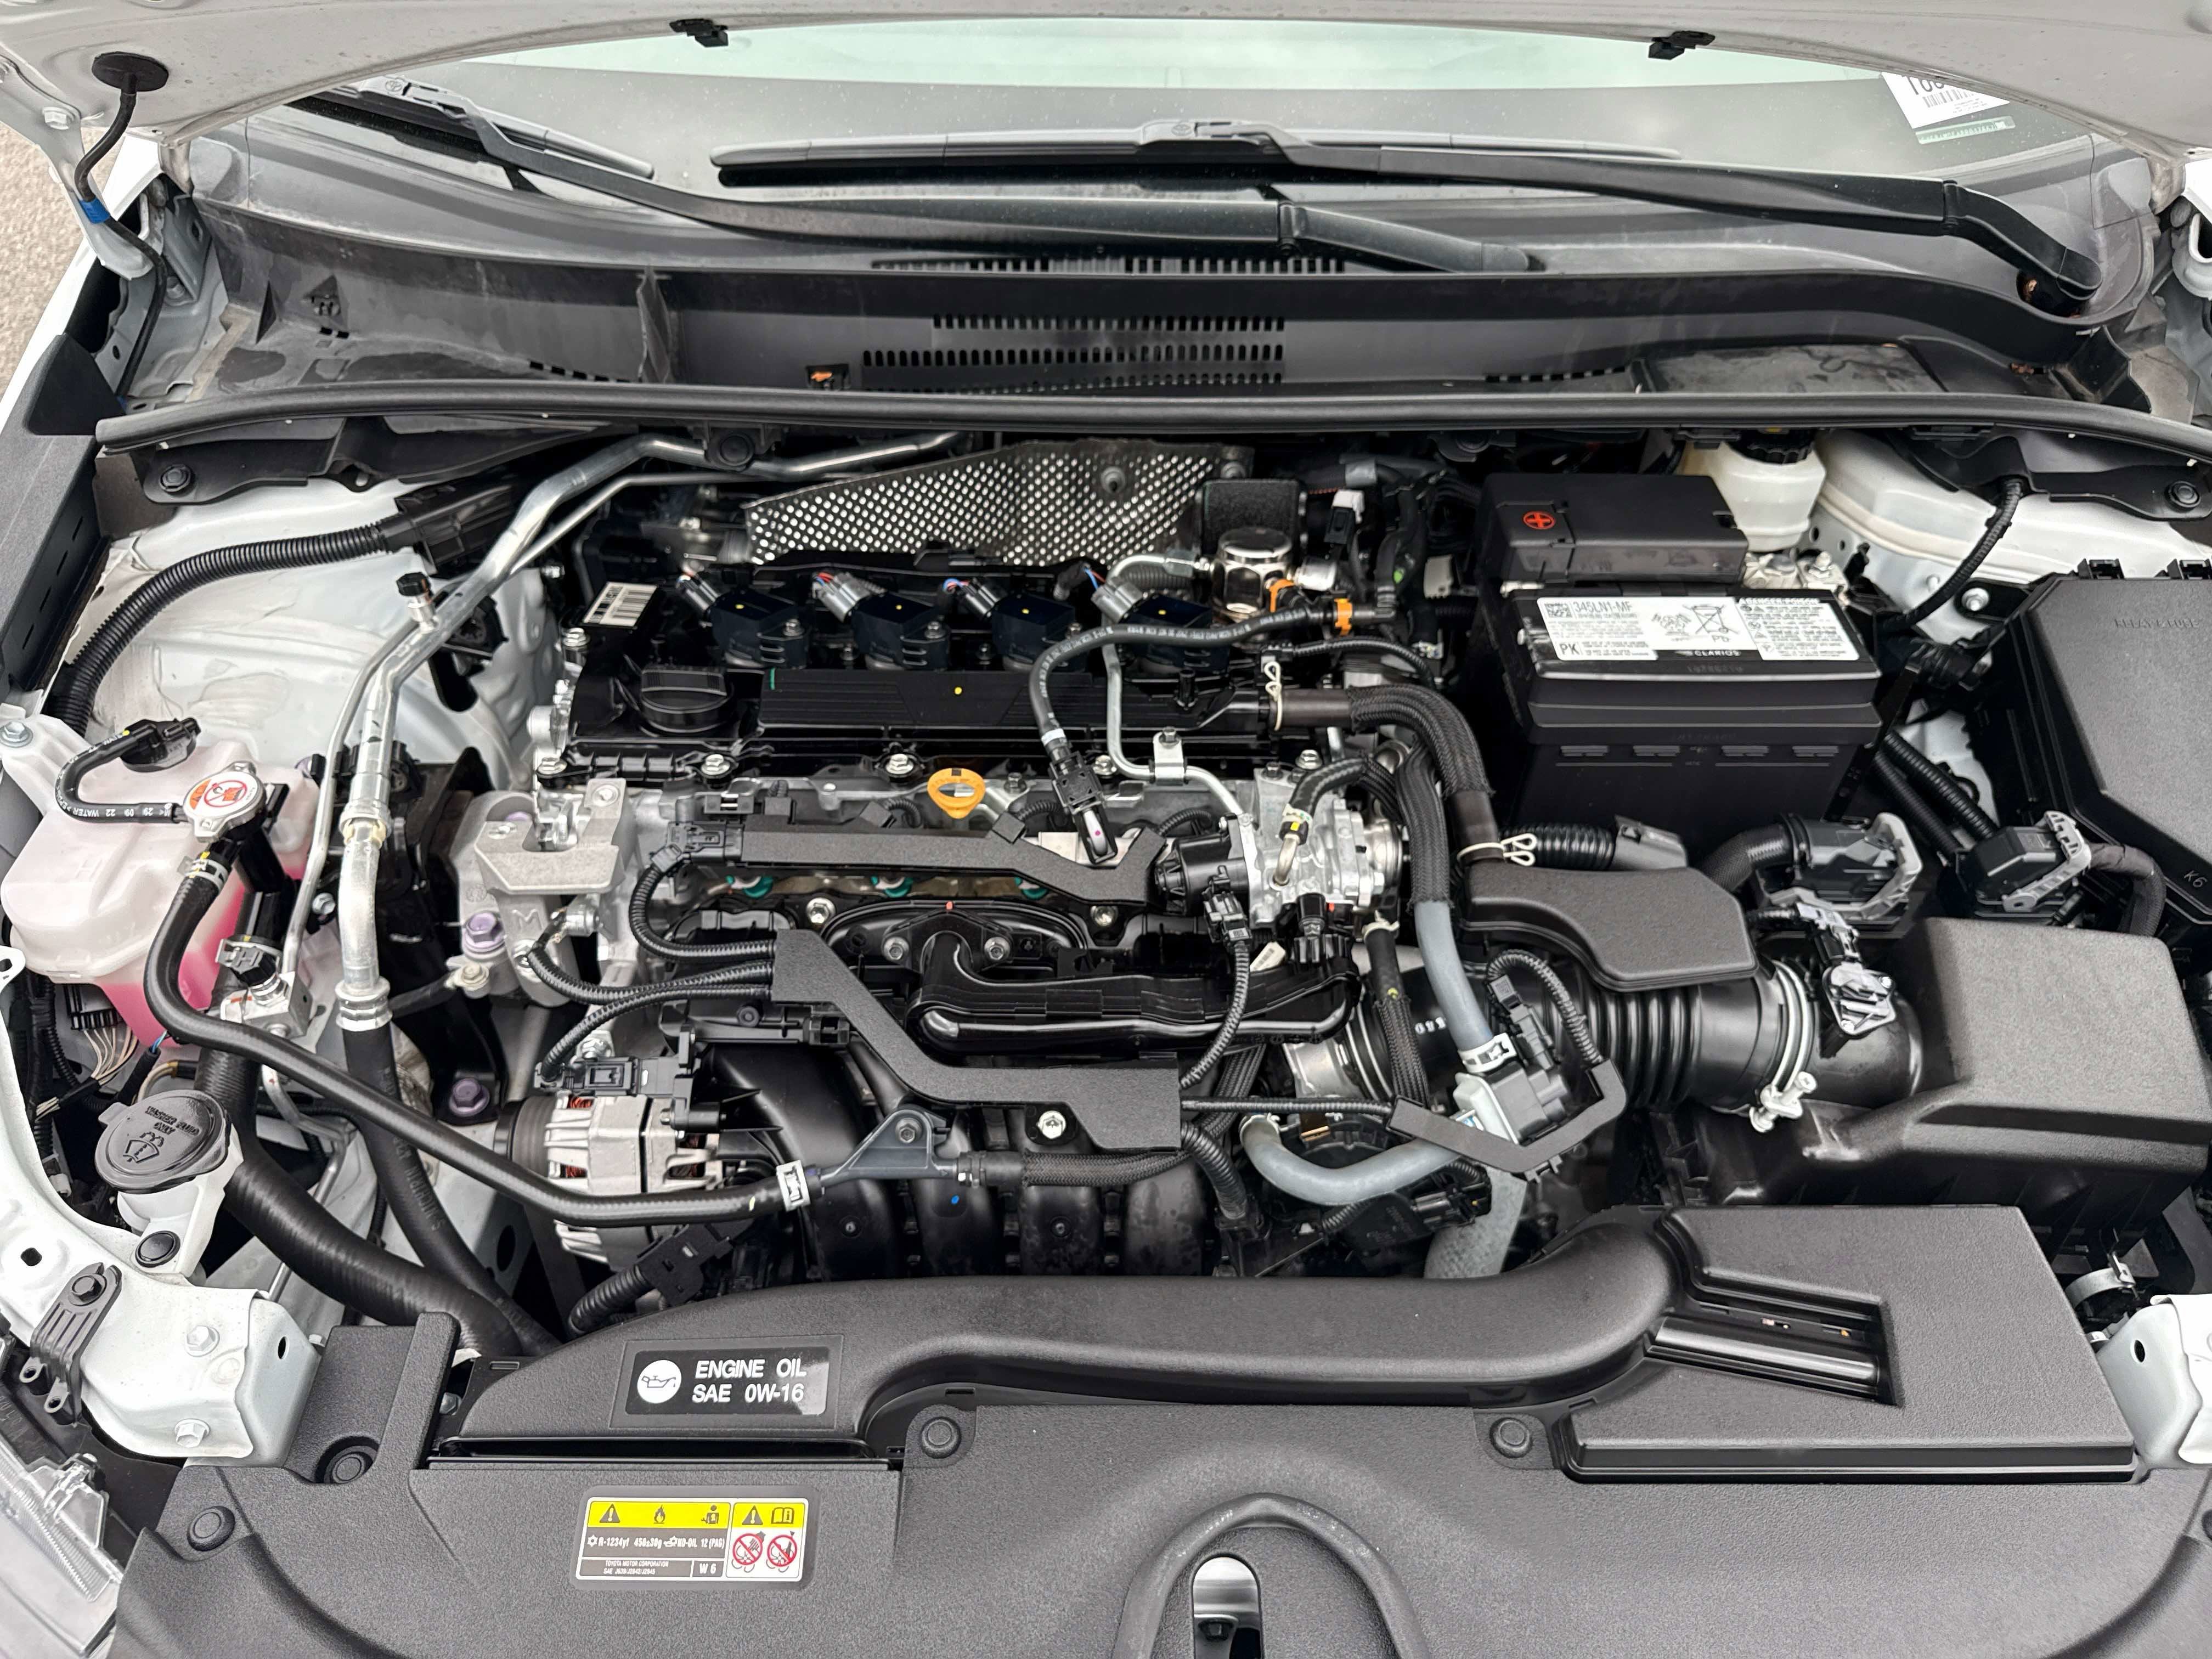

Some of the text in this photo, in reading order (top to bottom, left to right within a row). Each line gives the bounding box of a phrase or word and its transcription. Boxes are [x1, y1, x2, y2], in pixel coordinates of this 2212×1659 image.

[1572, 601, 1633, 614] 345LN1-MF
[1559, 643, 1581, 656] PK
[72, 806, 100, 817] WATER
[105, 808, 116, 817] 22
[694, 1358, 808, 1380] ENGINE OIL
[691, 1383, 805, 1404] SAE 0W-16
[598, 1537, 630, 1549] R-1234yf
[701, 1538, 709, 1548] 12
[708, 1538, 725, 1550] (PAG)
[699, 1563, 717, 1575] W 6
